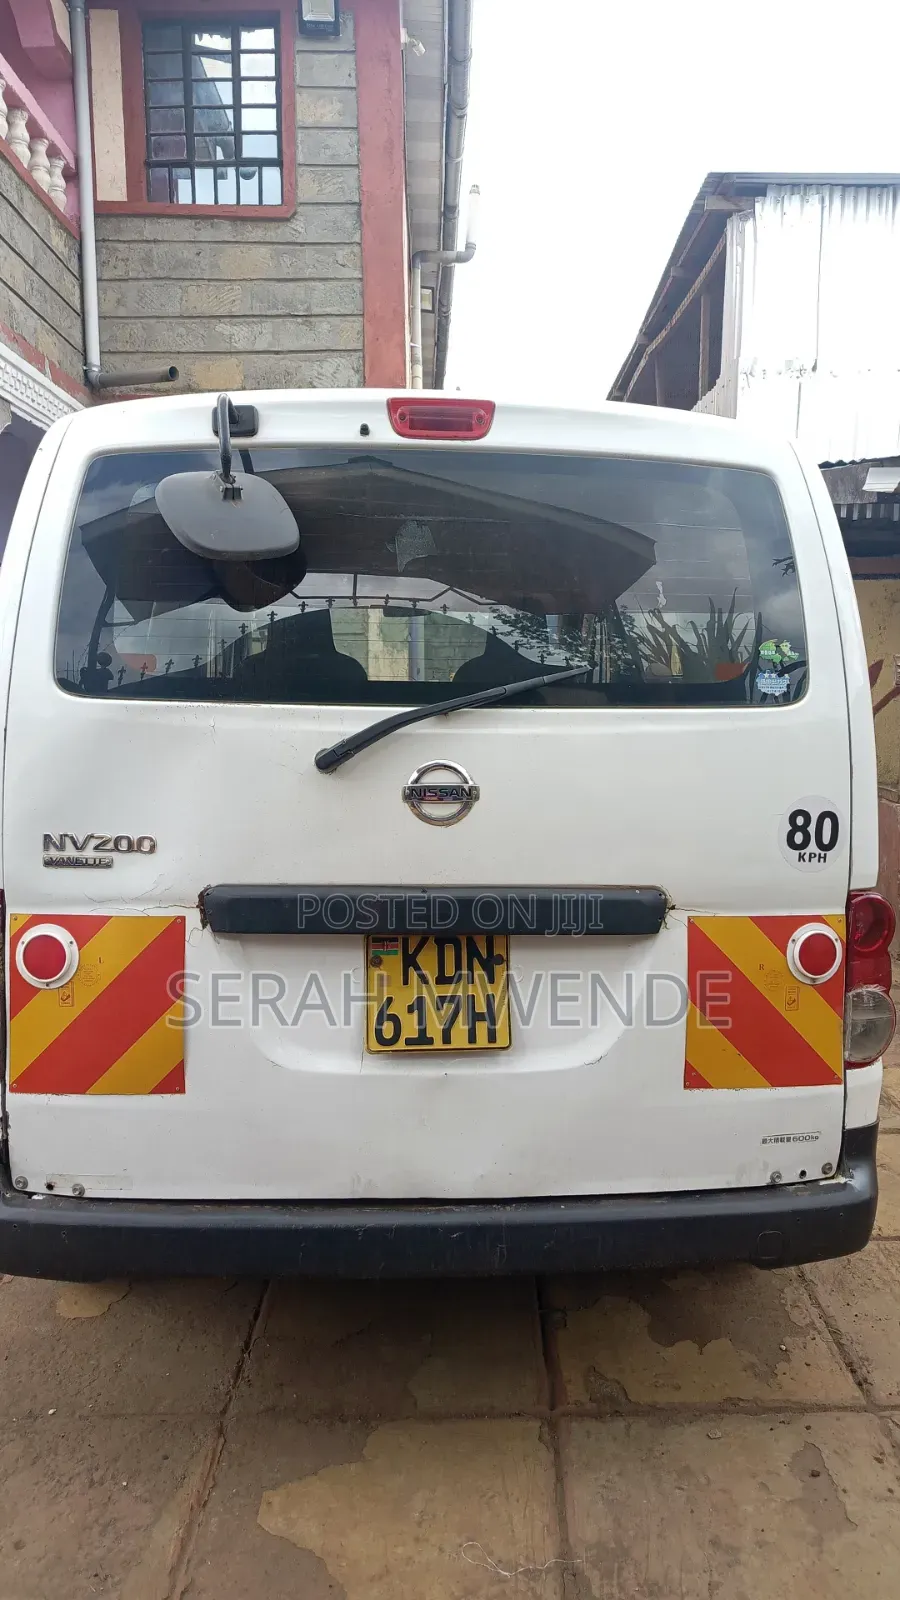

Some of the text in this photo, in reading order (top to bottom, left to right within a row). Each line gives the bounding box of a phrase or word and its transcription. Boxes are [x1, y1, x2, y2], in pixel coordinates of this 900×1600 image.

[411, 788, 472, 798] NISSAN
[786, 808, 839, 852] 80
[43, 832, 157, 854] NV200
[48, 856, 109, 866] VANETTE
[797, 852, 827, 863] KPH
[402, 936, 496, 985] KDN
[374, 993, 497, 1046] 617H
